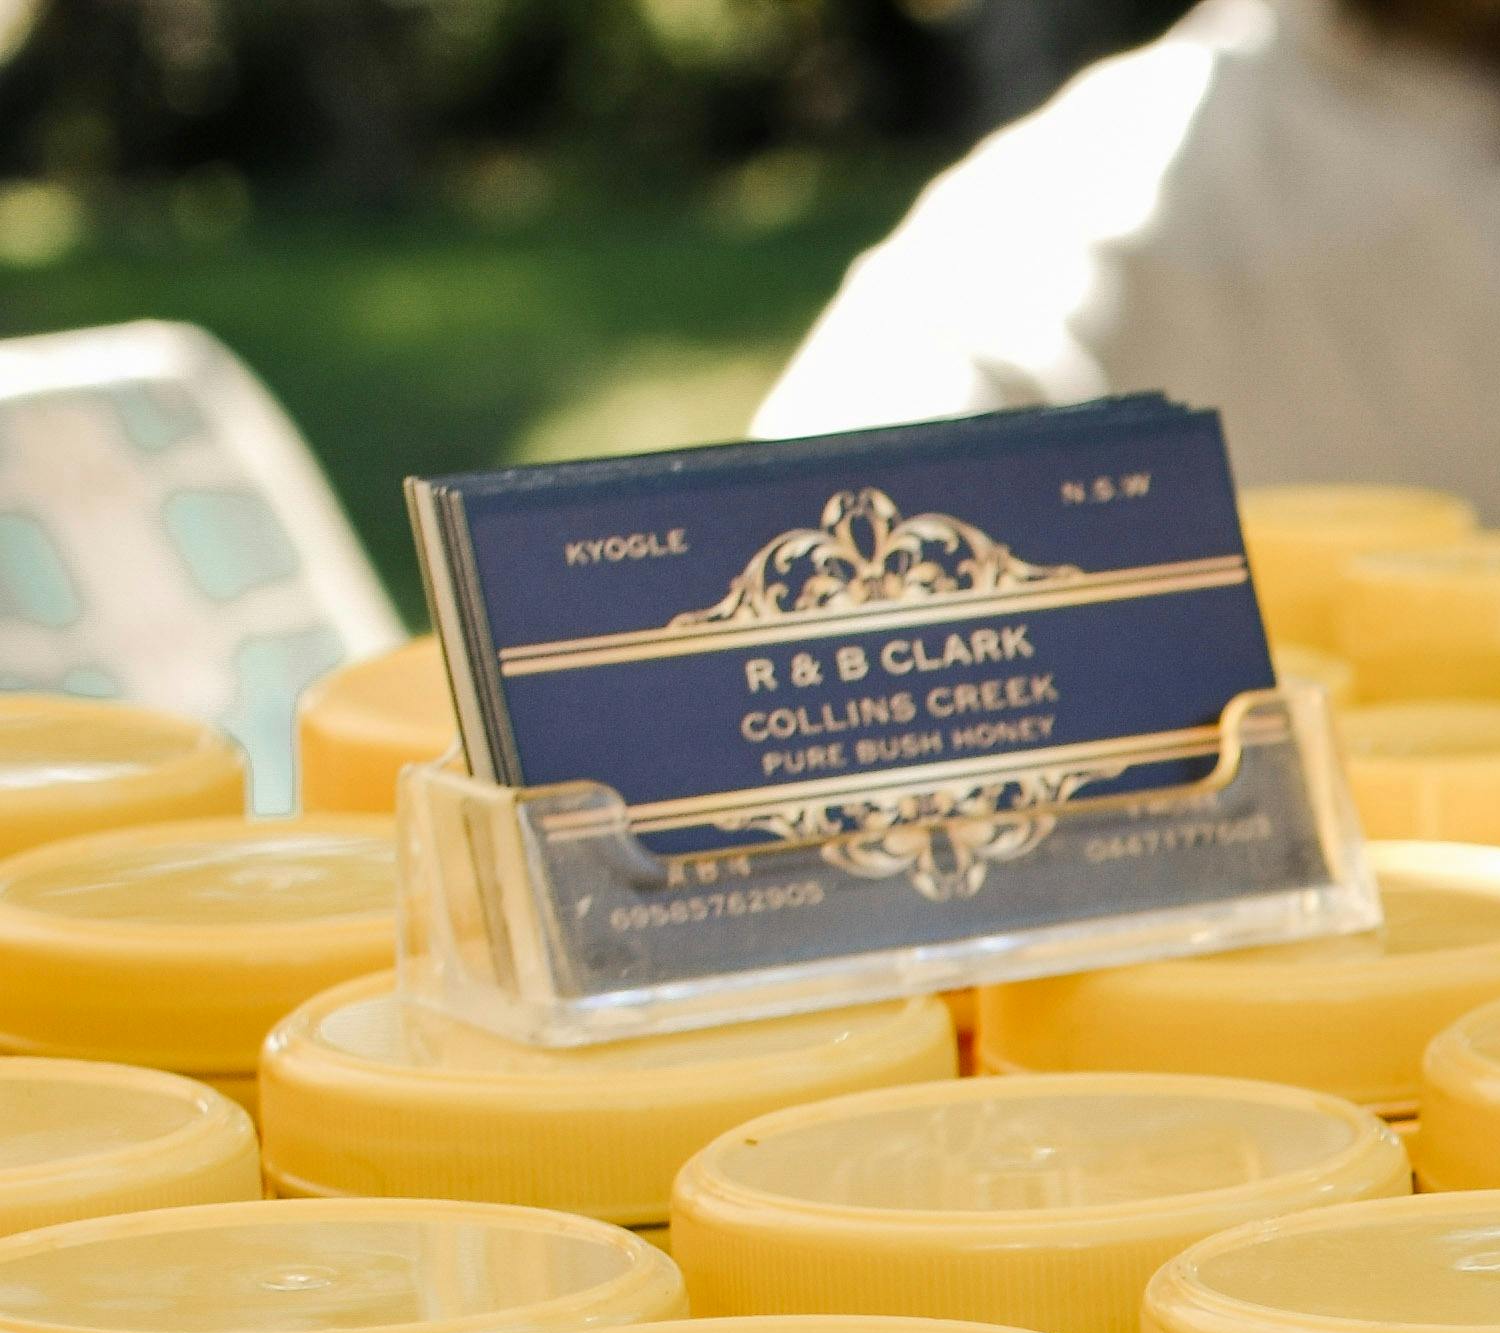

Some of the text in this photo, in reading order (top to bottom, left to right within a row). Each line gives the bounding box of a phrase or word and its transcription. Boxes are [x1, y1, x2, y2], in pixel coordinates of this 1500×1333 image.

[565, 529, 688, 566] KYOGLE
[745, 624, 1034, 692] R & B CLARK
[740, 673, 1059, 742] COLLINS CREEK
[761, 713, 1055, 777] PURE BUSH HONEY
